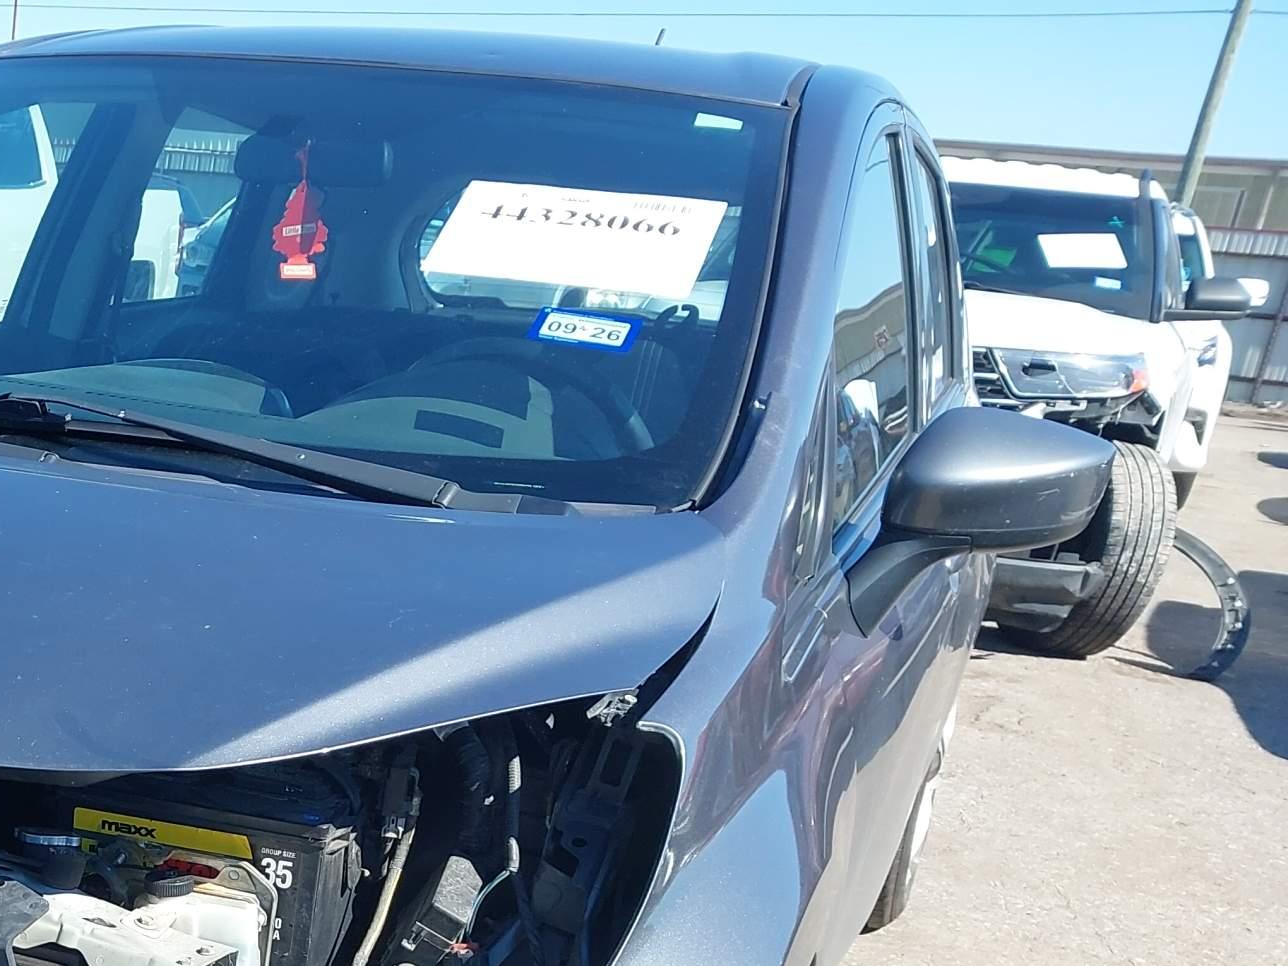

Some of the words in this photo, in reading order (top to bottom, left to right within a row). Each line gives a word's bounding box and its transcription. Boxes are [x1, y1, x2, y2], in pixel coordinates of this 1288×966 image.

[481, 203, 682, 237] 44328066
[548, 320, 577, 334] 09
[590, 327, 622, 341] 26
[101, 819, 157, 839] maxx
[261, 847, 282, 856] GROUP
[282, 851, 297, 859] SIZE
[261, 857, 294, 889] 35
